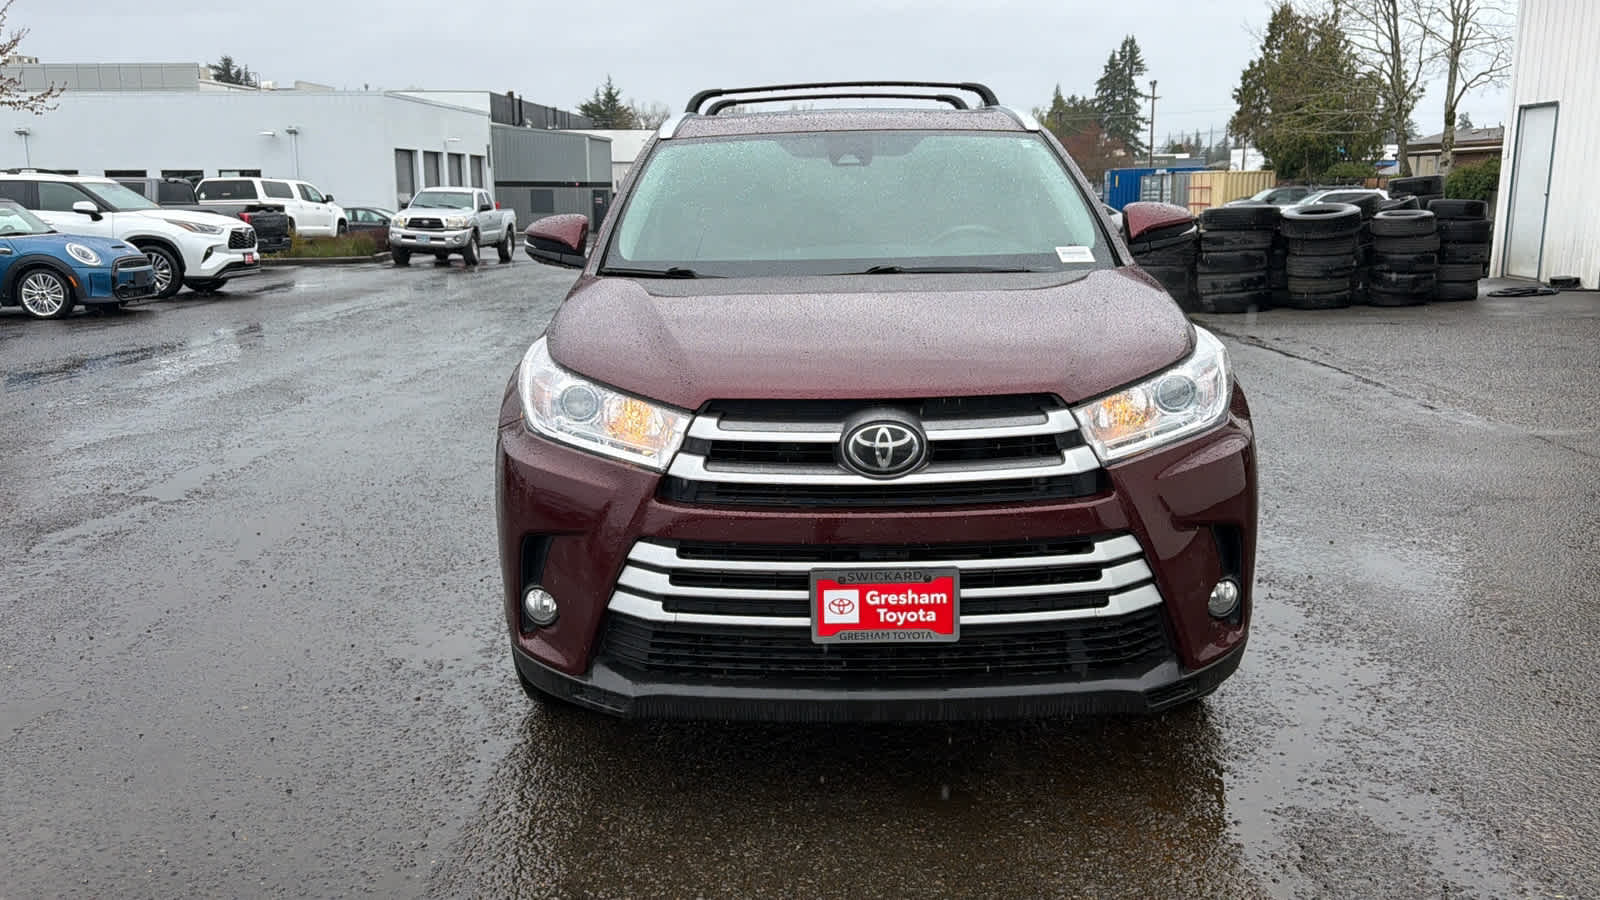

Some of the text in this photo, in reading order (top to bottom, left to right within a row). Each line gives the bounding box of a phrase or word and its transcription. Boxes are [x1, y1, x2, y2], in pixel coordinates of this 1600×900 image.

[847, 571, 922, 582] SWICKARD
[866, 589, 947, 605] Gresham
[876, 608, 937, 625] Toyota
[839, 631, 933, 641] GRESHAM TOYOTA
